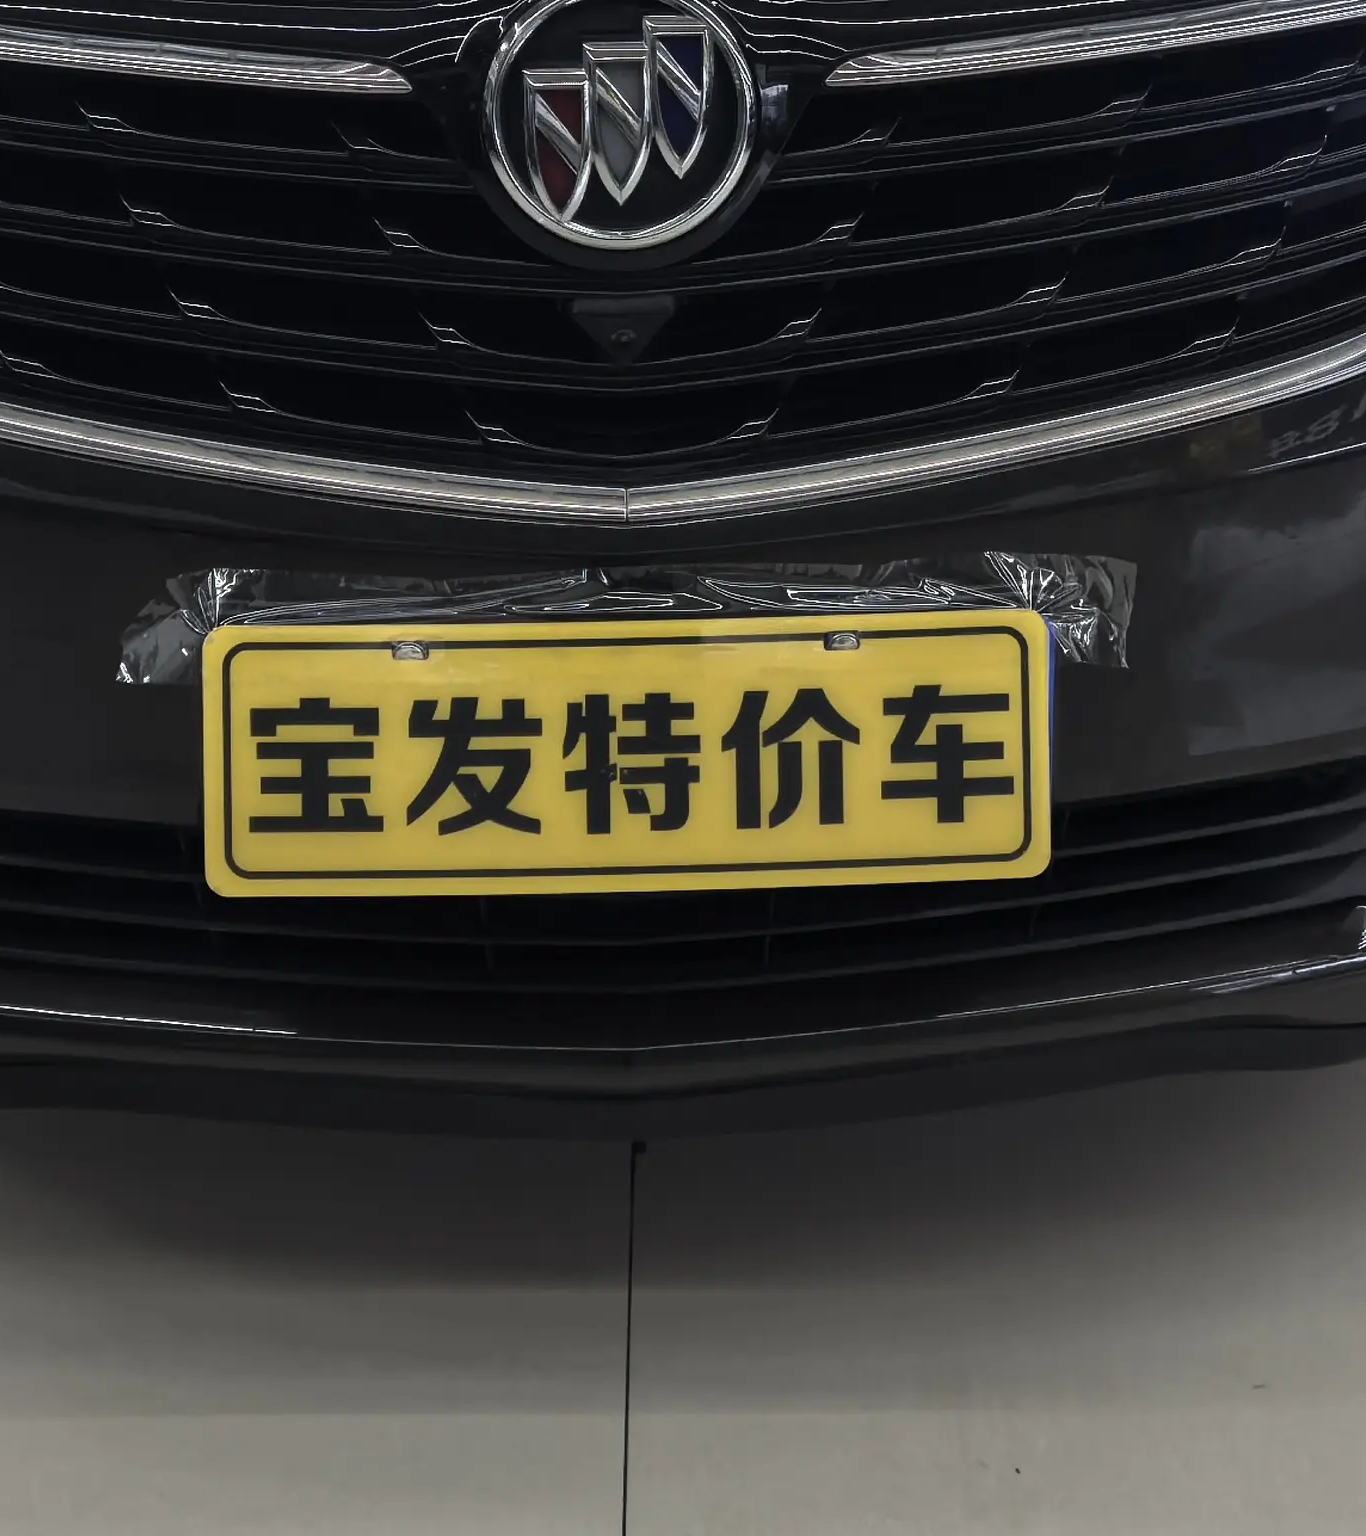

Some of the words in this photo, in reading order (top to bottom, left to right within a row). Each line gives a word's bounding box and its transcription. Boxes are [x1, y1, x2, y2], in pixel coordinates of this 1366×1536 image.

[247, 684, 1015, 835] 宝发特价车
